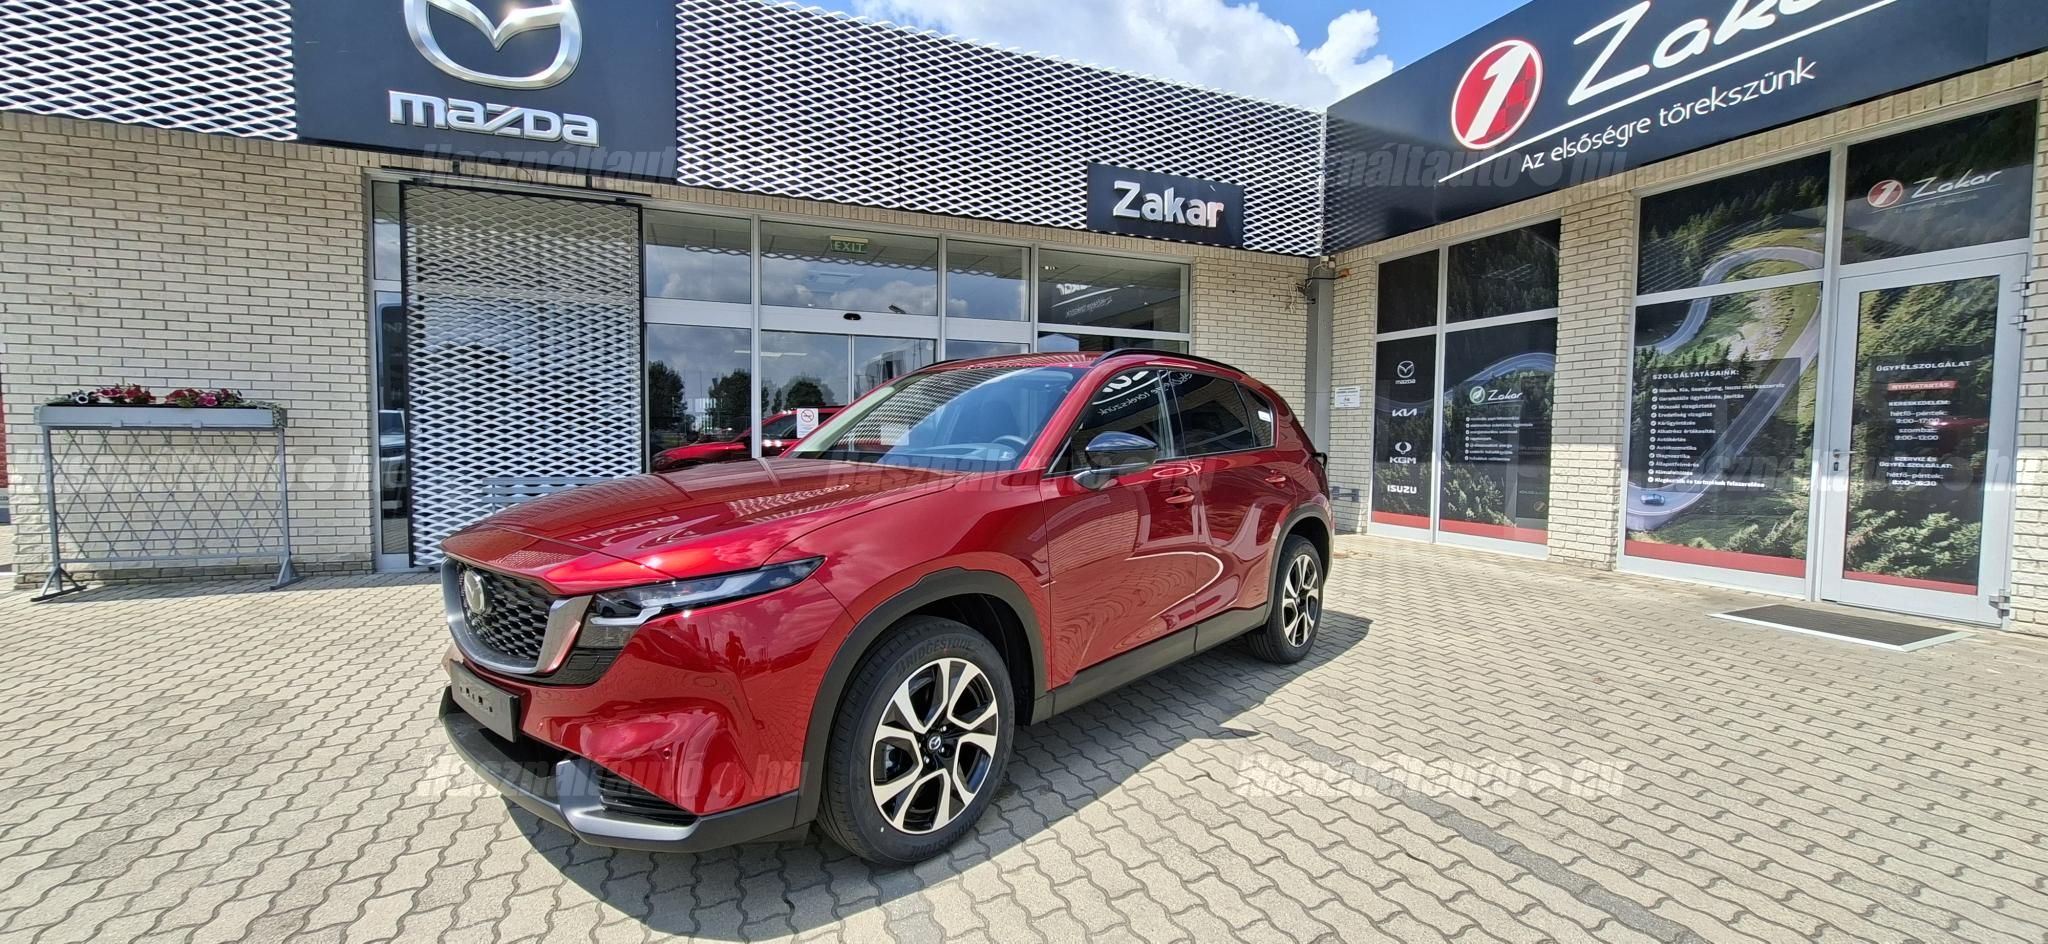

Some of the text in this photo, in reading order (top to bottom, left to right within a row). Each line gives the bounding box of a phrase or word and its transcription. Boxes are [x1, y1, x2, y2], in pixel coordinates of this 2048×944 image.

[1520, 56, 1818, 173] Az elsőségre törekszünk
[1911, 168, 2003, 199] Zakar
[1112, 179, 1225, 228] Zakar
[834, 241, 866, 253] EXIT
[1876, 360, 1972, 372] ÜGYFÉLSZOLGÁLAT
[1652, 369, 1740, 381] SZOLGÁLTATÁSAINK:
[1487, 388, 1524, 401] Zakar
[1389, 456, 1417, 464] KGM
[1387, 484, 1417, 494] ISUZU
